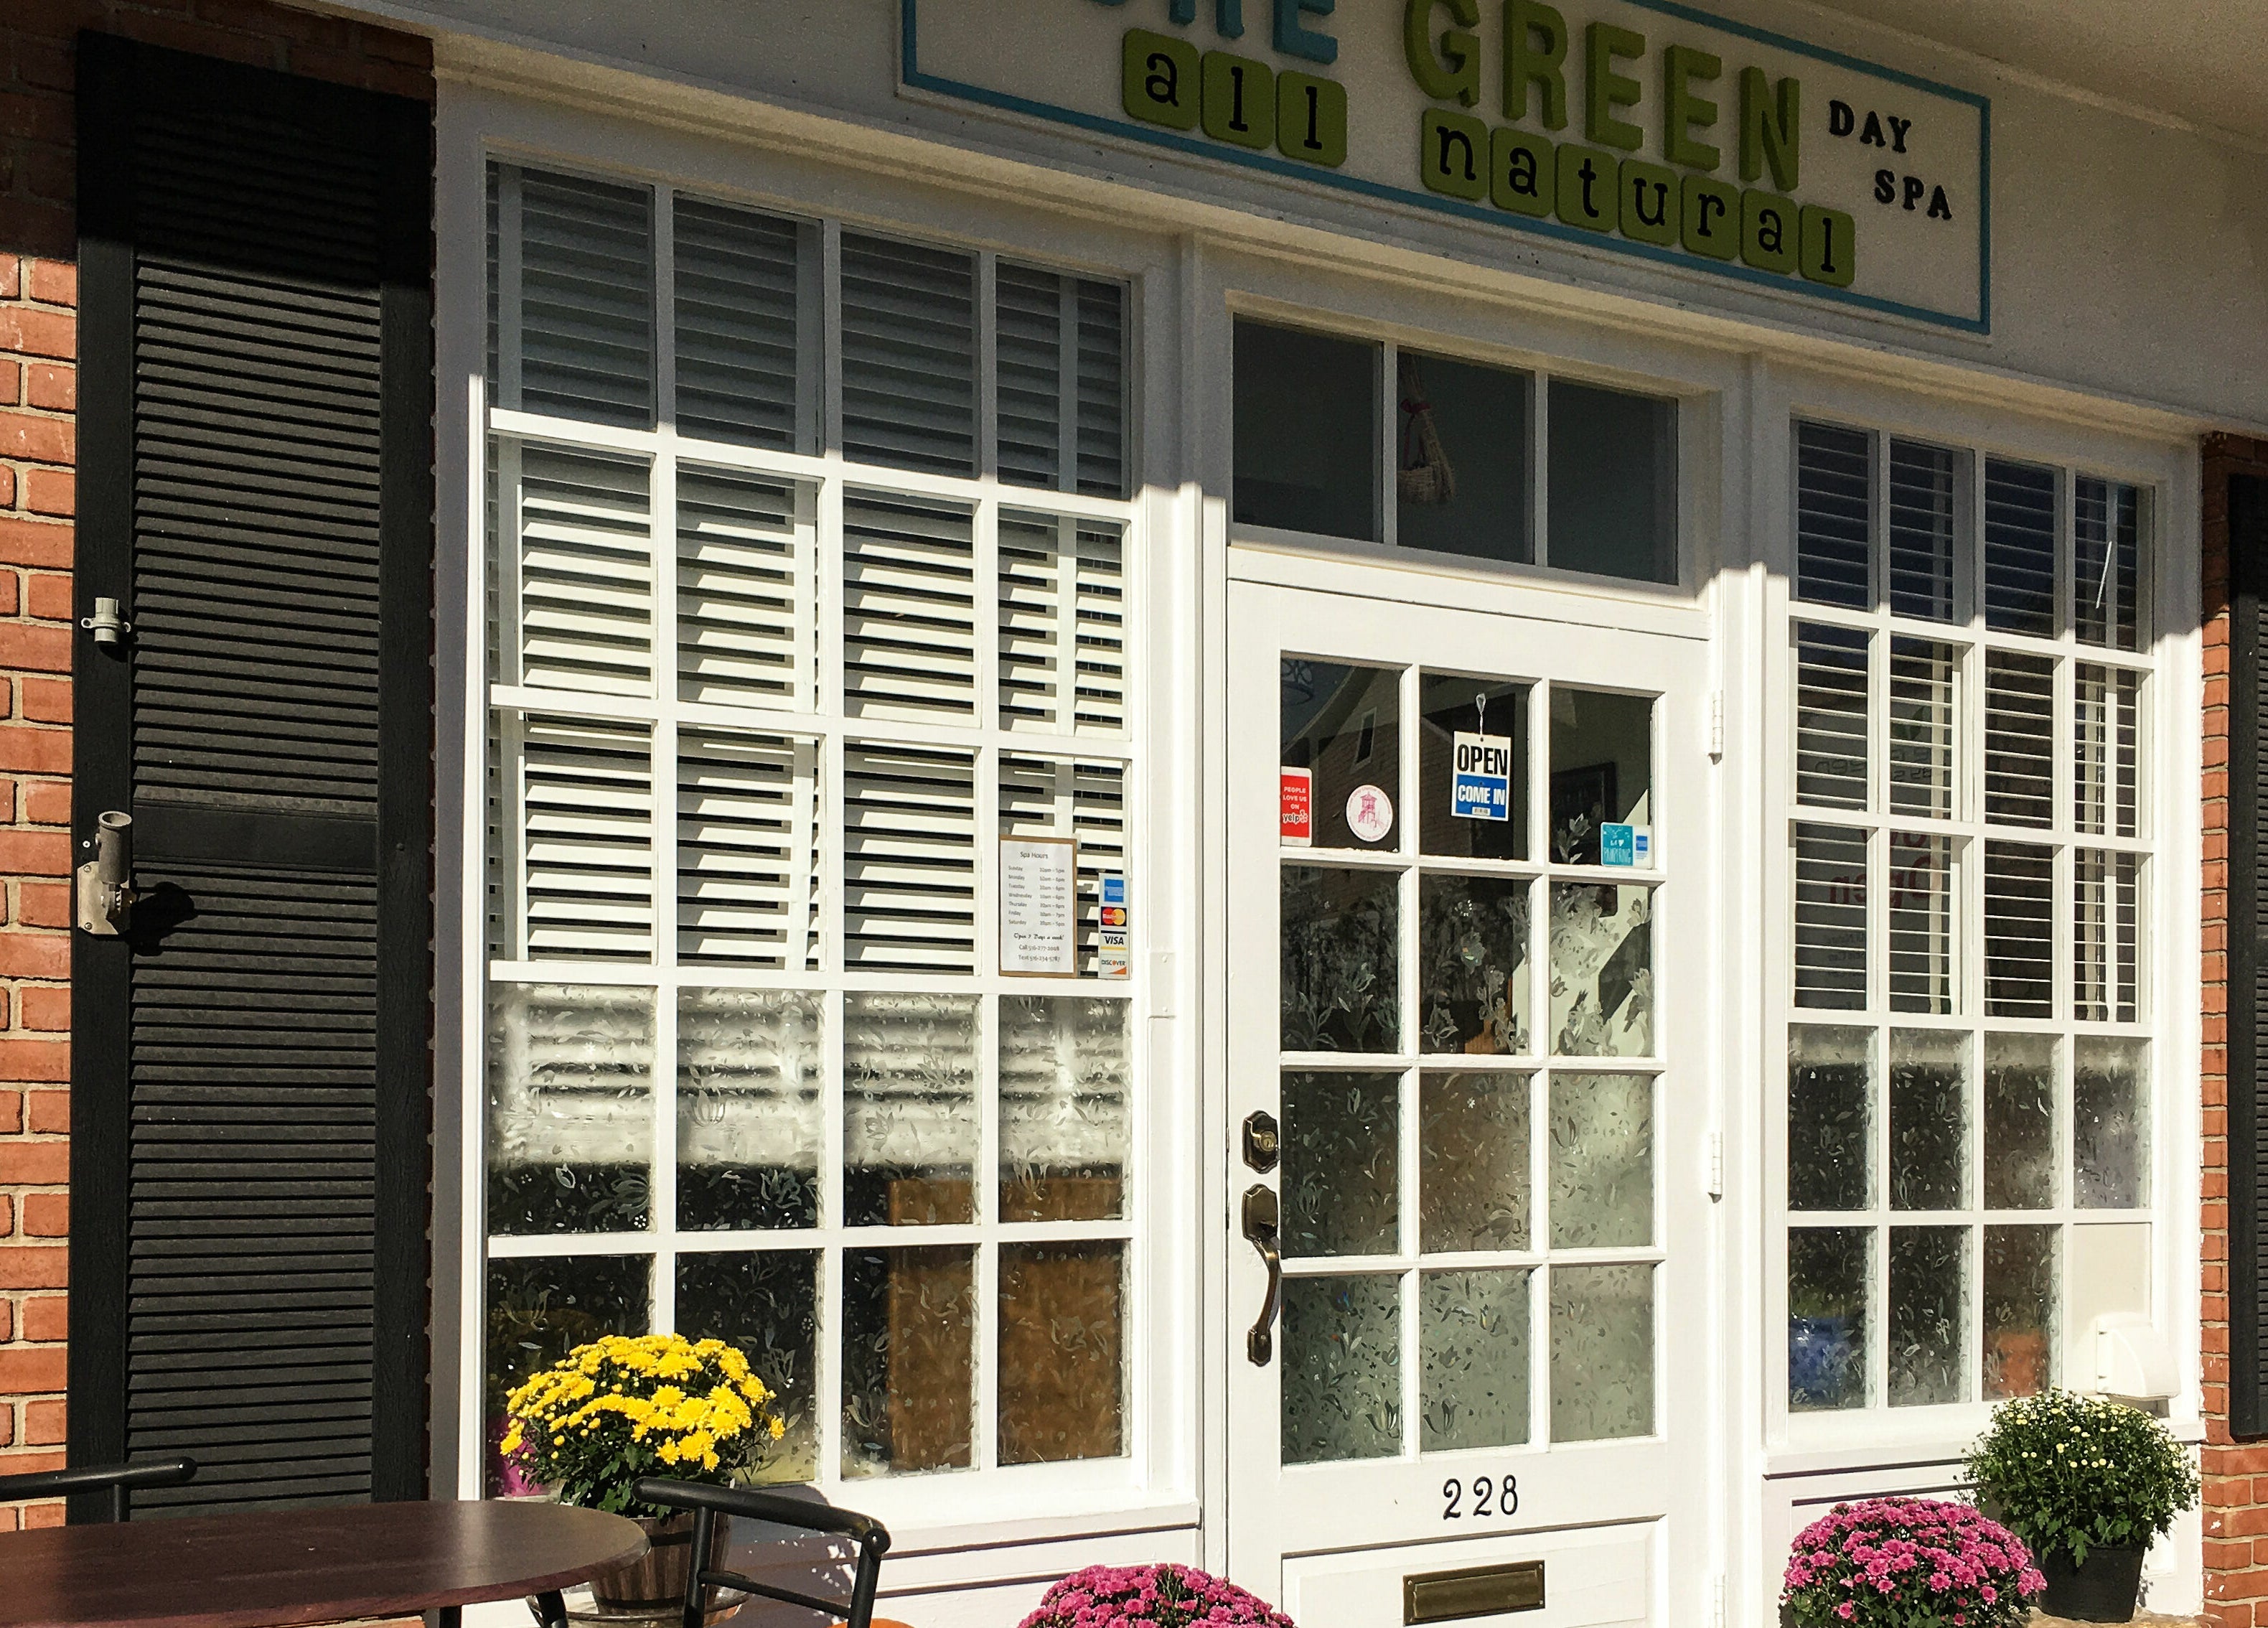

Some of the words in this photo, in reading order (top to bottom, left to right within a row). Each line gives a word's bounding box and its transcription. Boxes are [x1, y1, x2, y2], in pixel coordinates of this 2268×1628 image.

[1403, 0, 1800, 193] GREEN
[1828, 99, 1912, 154] DAY
[1145, 52, 1323, 151] all
[1436, 124, 1837, 274] natural
[1873, 169, 1954, 220] SPA
[1456, 744, 1508, 776] OPEN
[1458, 784, 1491, 804] COME
[1493, 788, 1506, 805] IN
[1283, 813, 1300, 823] yelp
[1104, 935, 1125, 945] VISA
[1443, 1474, 1519, 1520] 228
